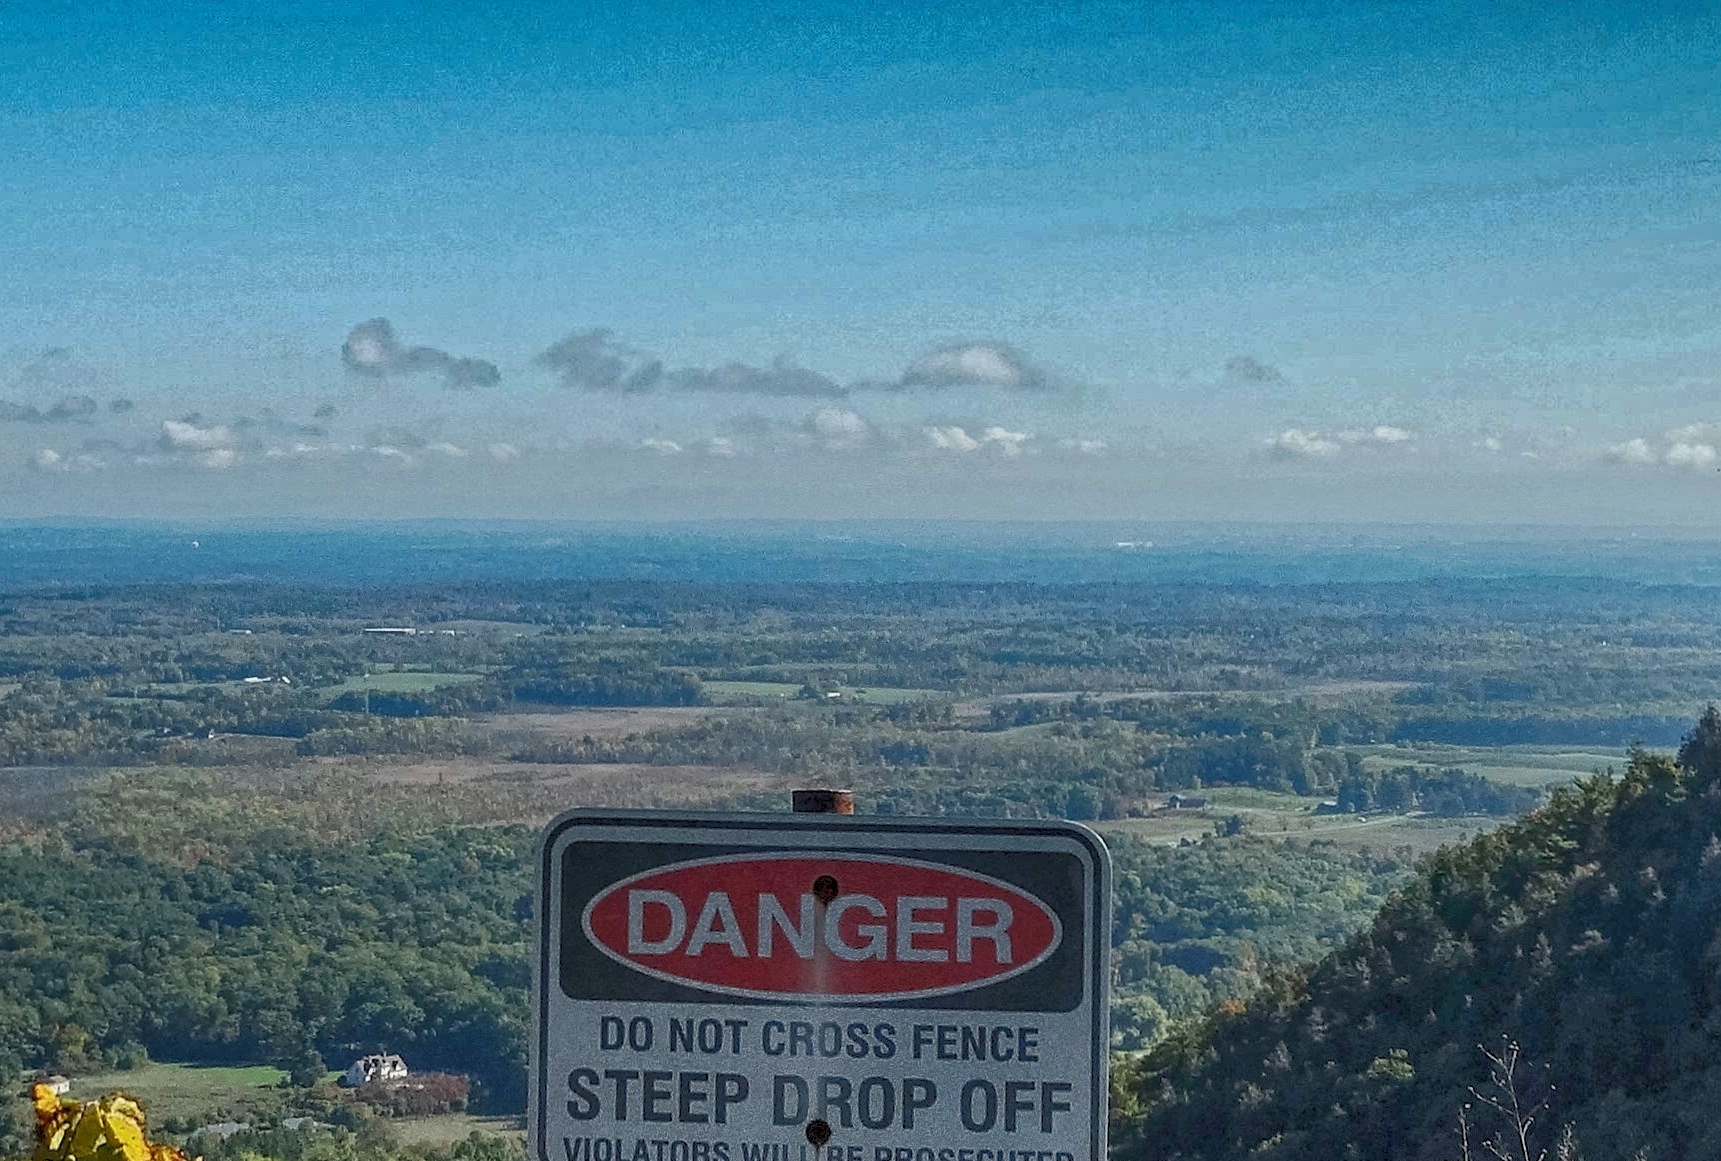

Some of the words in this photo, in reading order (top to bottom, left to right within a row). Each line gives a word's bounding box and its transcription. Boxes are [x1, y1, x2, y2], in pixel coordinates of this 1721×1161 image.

[626, 889, 1015, 965] DANGER
[600, 1016, 653, 1052] DO
[670, 1018, 748, 1055] NOT
[762, 1021, 896, 1060] CROSS
[913, 1025, 1039, 1063] FENCE
[567, 1067, 749, 1124] STEEP
[772, 1074, 936, 1130] DROP
[960, 1079, 1072, 1134] OFF
